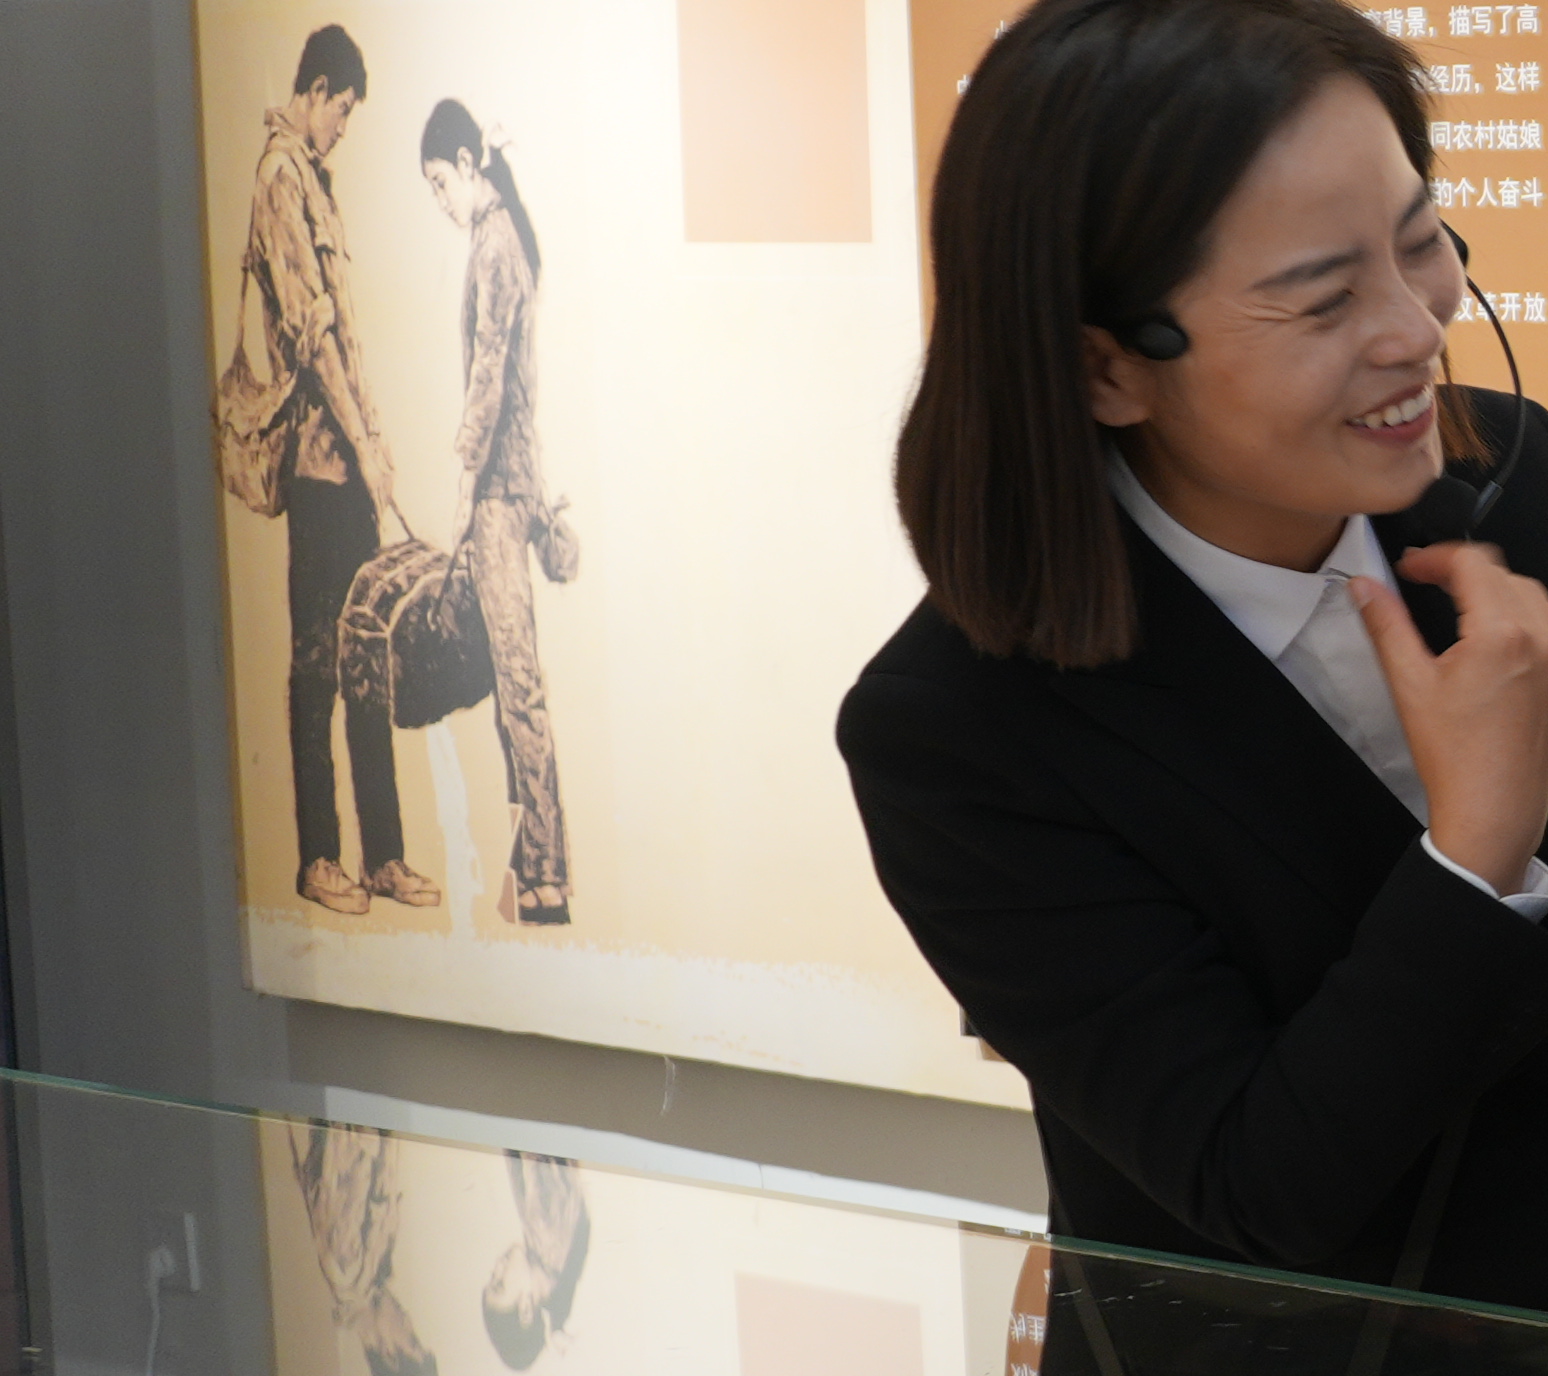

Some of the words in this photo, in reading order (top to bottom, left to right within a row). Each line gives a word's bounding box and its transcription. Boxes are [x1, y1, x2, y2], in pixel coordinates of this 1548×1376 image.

[1431, 119, 1543, 151] 同农村姑娘
